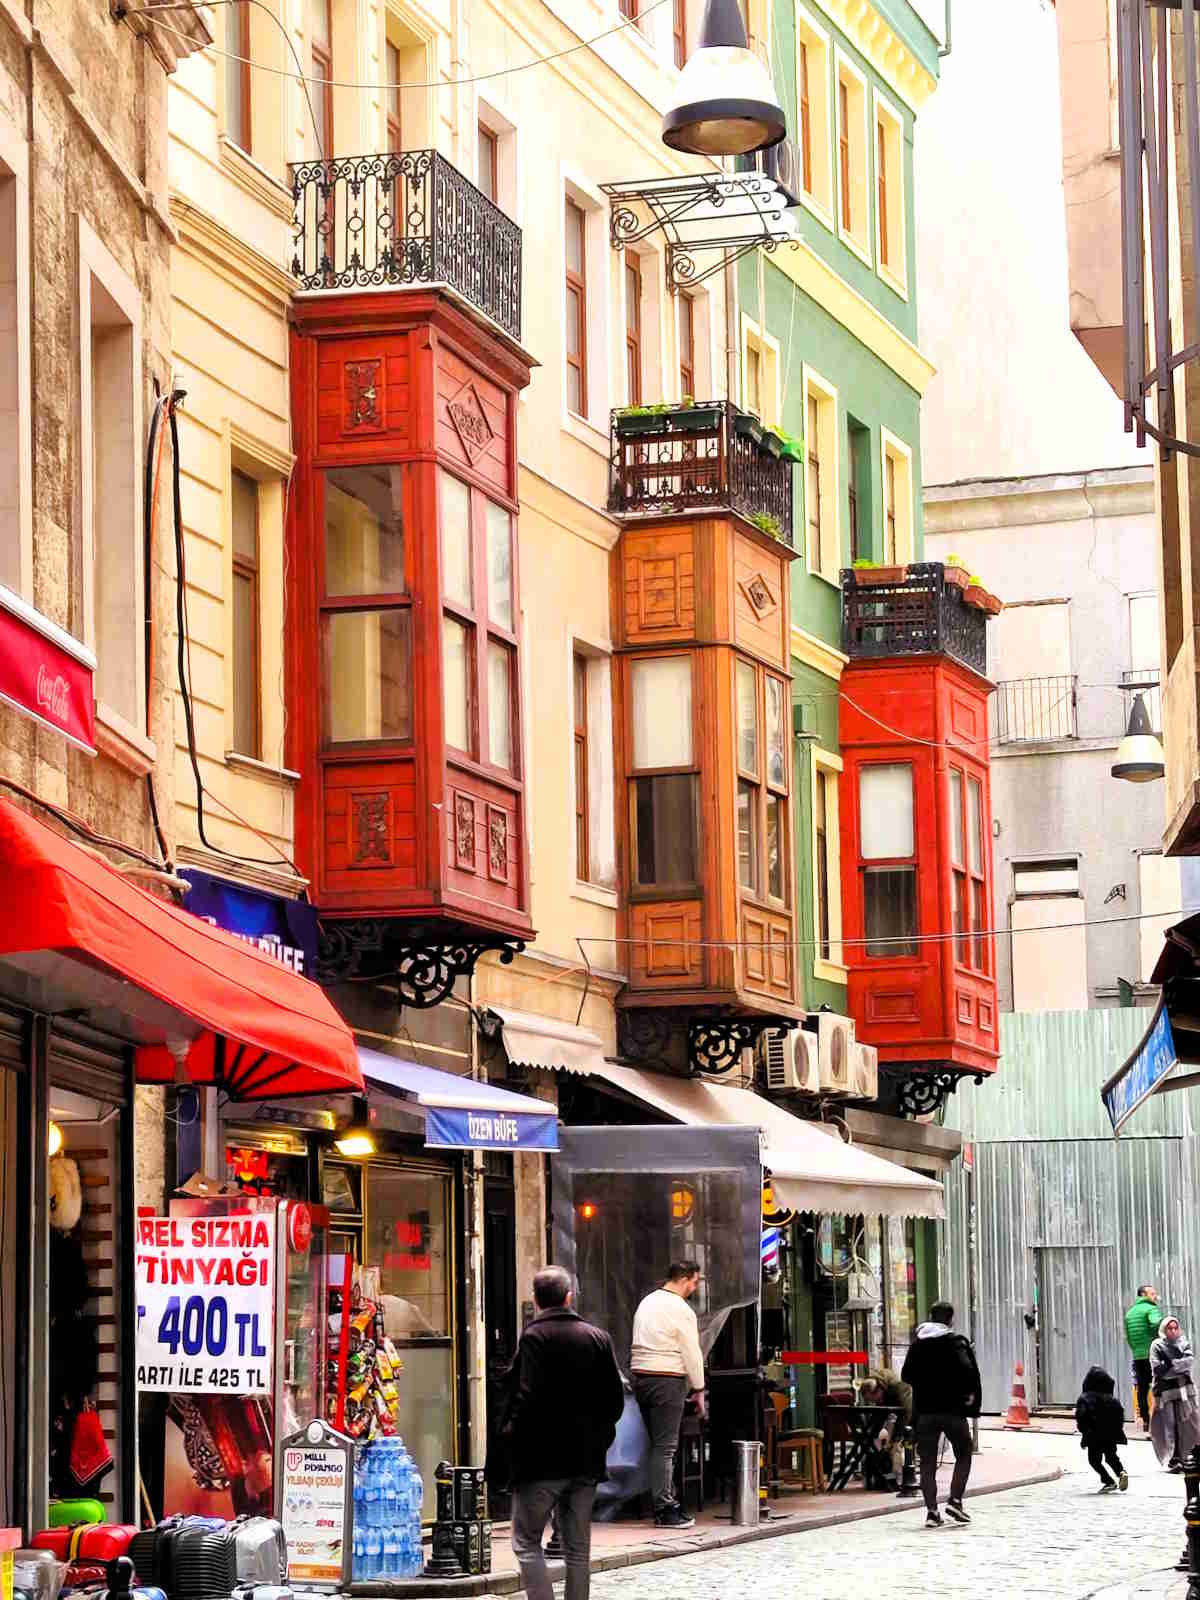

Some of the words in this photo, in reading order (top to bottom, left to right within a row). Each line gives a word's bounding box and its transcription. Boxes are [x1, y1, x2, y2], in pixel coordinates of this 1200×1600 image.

[467, 1111, 493, 1140] ÖZEN
[495, 1113, 519, 1142] BÜFE
[137, 1220, 184, 1247] REL
[191, 1220, 269, 1248] SIZMA
[137, 1250, 269, 1286] TİNYAĞI
[158, 1295, 228, 1357] 400
[234, 1313, 267, 1357] TL
[179, 1361, 203, 1386] İLE
[208, 1367, 239, 1387] 425
[246, 1368, 265, 1387] TL
